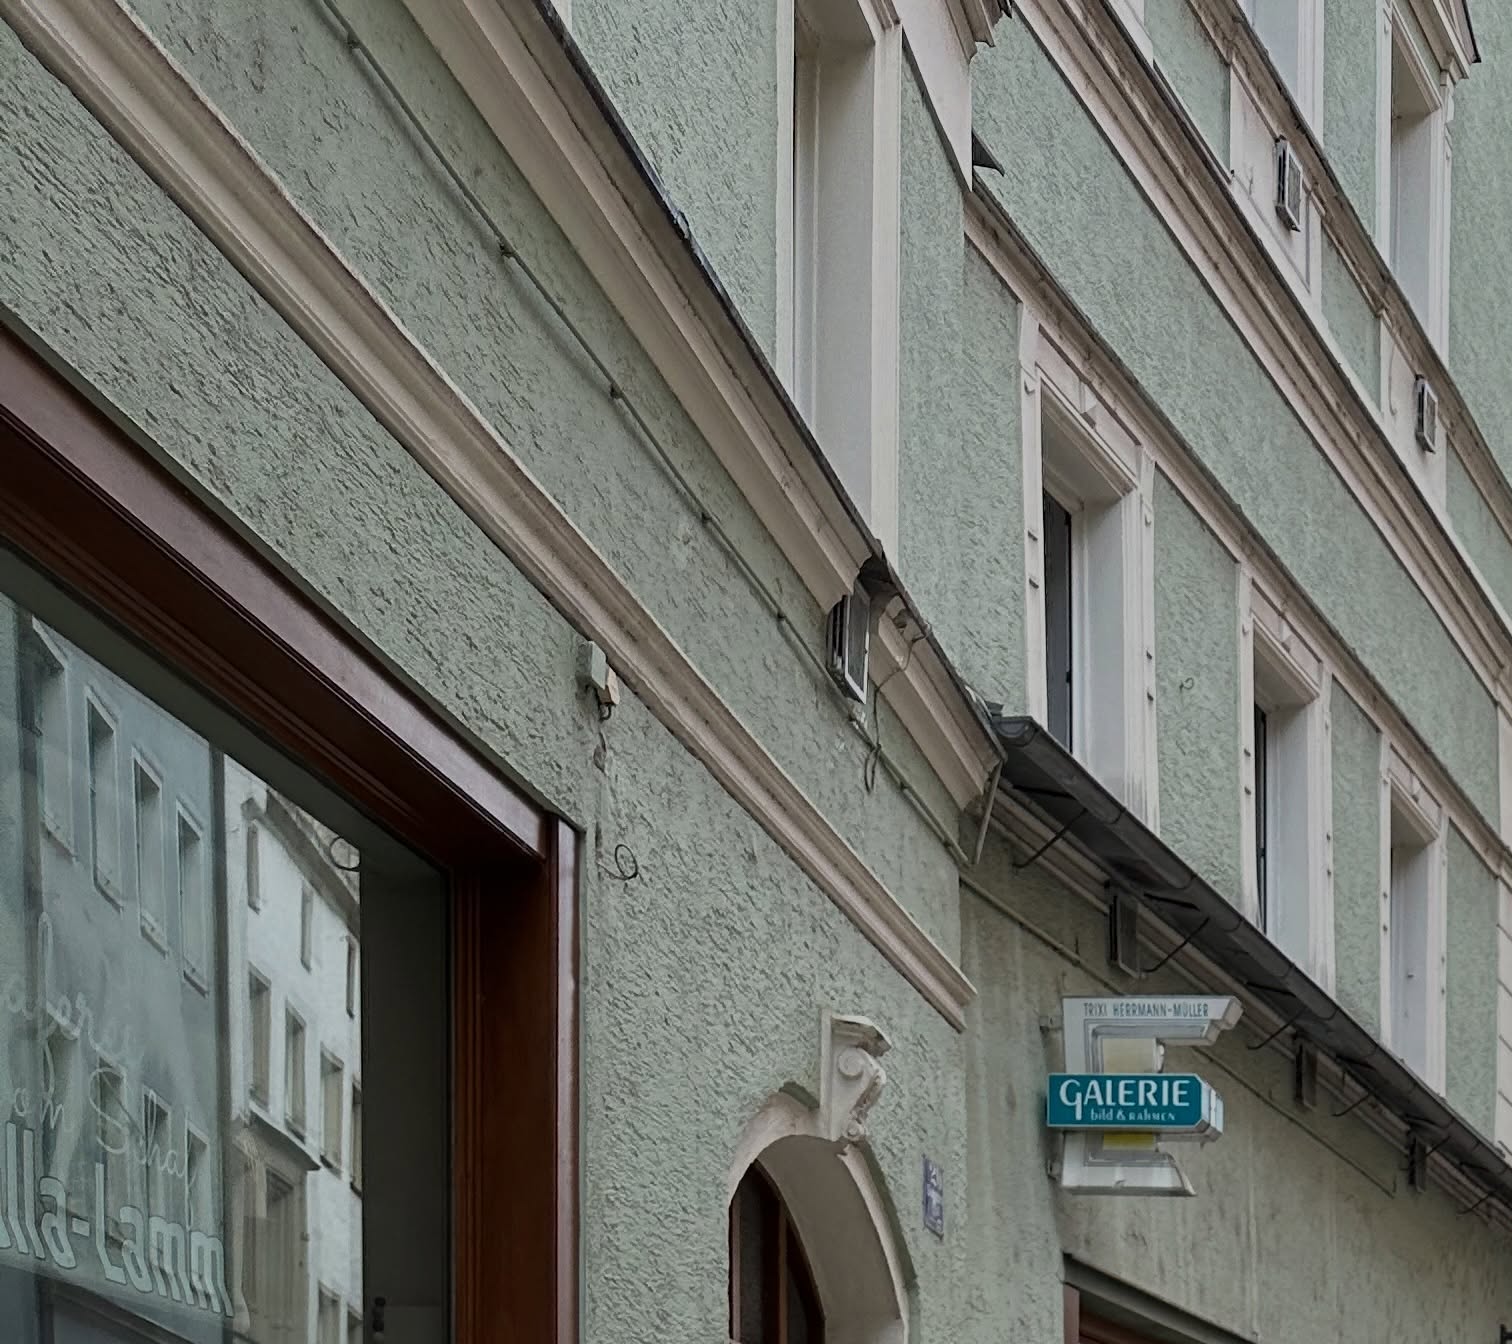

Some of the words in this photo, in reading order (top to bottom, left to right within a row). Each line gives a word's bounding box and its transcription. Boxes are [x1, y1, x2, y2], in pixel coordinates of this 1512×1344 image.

[1083, 1002, 1107, 1017] TRIXI
[1113, 1001, 1209, 1017] HERRMANN-MÜLLER
[1059, 1079, 1191, 1121] GALERIE
